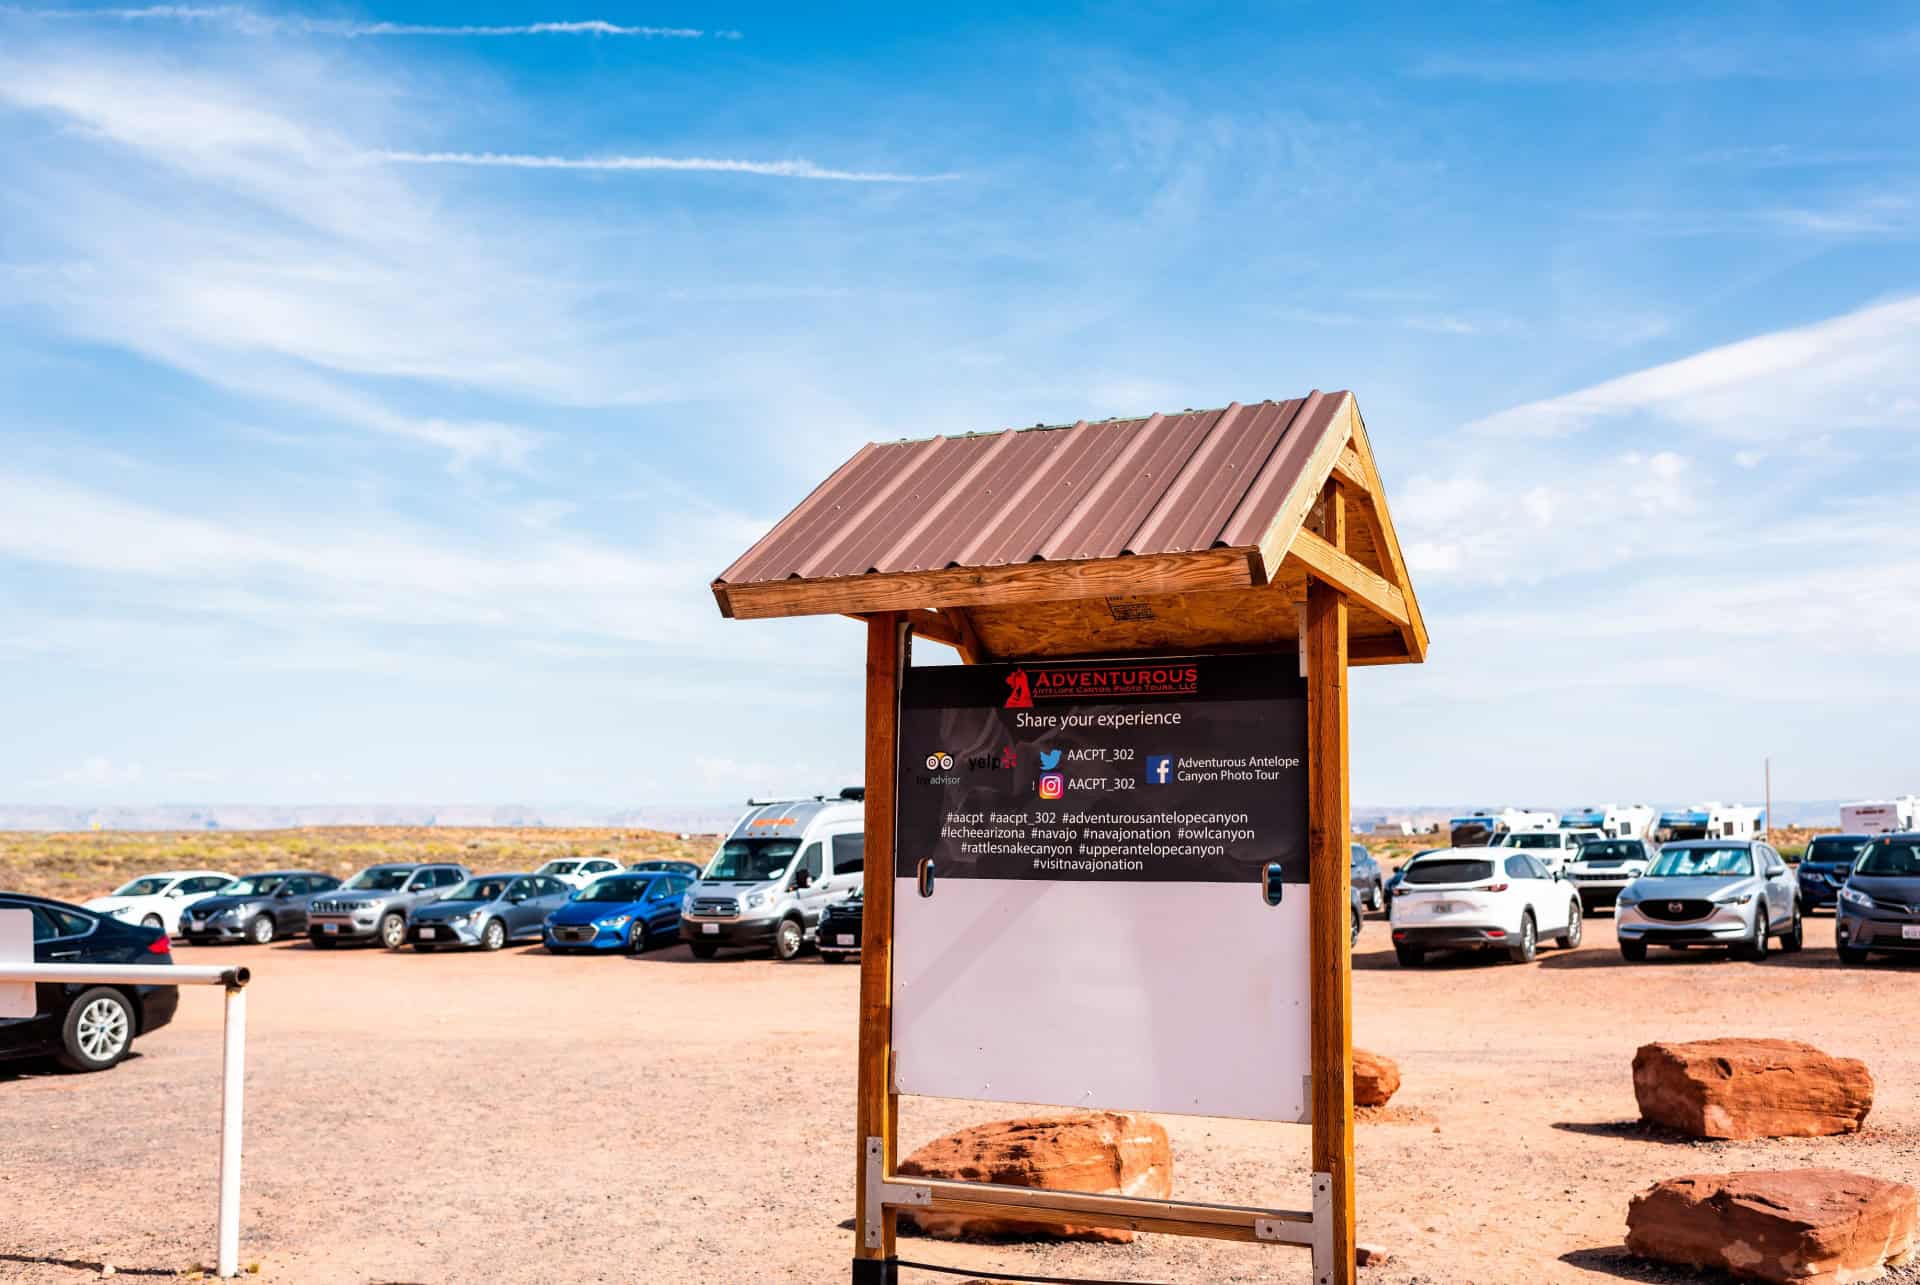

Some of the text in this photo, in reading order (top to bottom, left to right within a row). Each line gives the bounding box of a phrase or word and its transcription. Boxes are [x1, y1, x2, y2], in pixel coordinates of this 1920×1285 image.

[1035, 669, 1198, 687] ADVENTUROUS
[1016, 710, 1182, 730] Share your experience
[969, 755, 999, 770] yelp
[1067, 748, 1135, 762] AACPT_302
[1177, 756, 1300, 769] Adventurous Antelope
[1177, 769, 1280, 783] Canyon Photo Tour
[1067, 777, 1136, 791] AACPT_302
[947, 811, 1249, 827] #aacpt #aacpt_302 #adventurousantelopecanyon
[940, 826, 1256, 842] #lecheearizona #navajo #navajonation #owlcanyon
[961, 842, 1225, 859] #rattlesnakecanyon #upperantelopecanyon
[1033, 858, 1144, 872] #visitnavajonation
